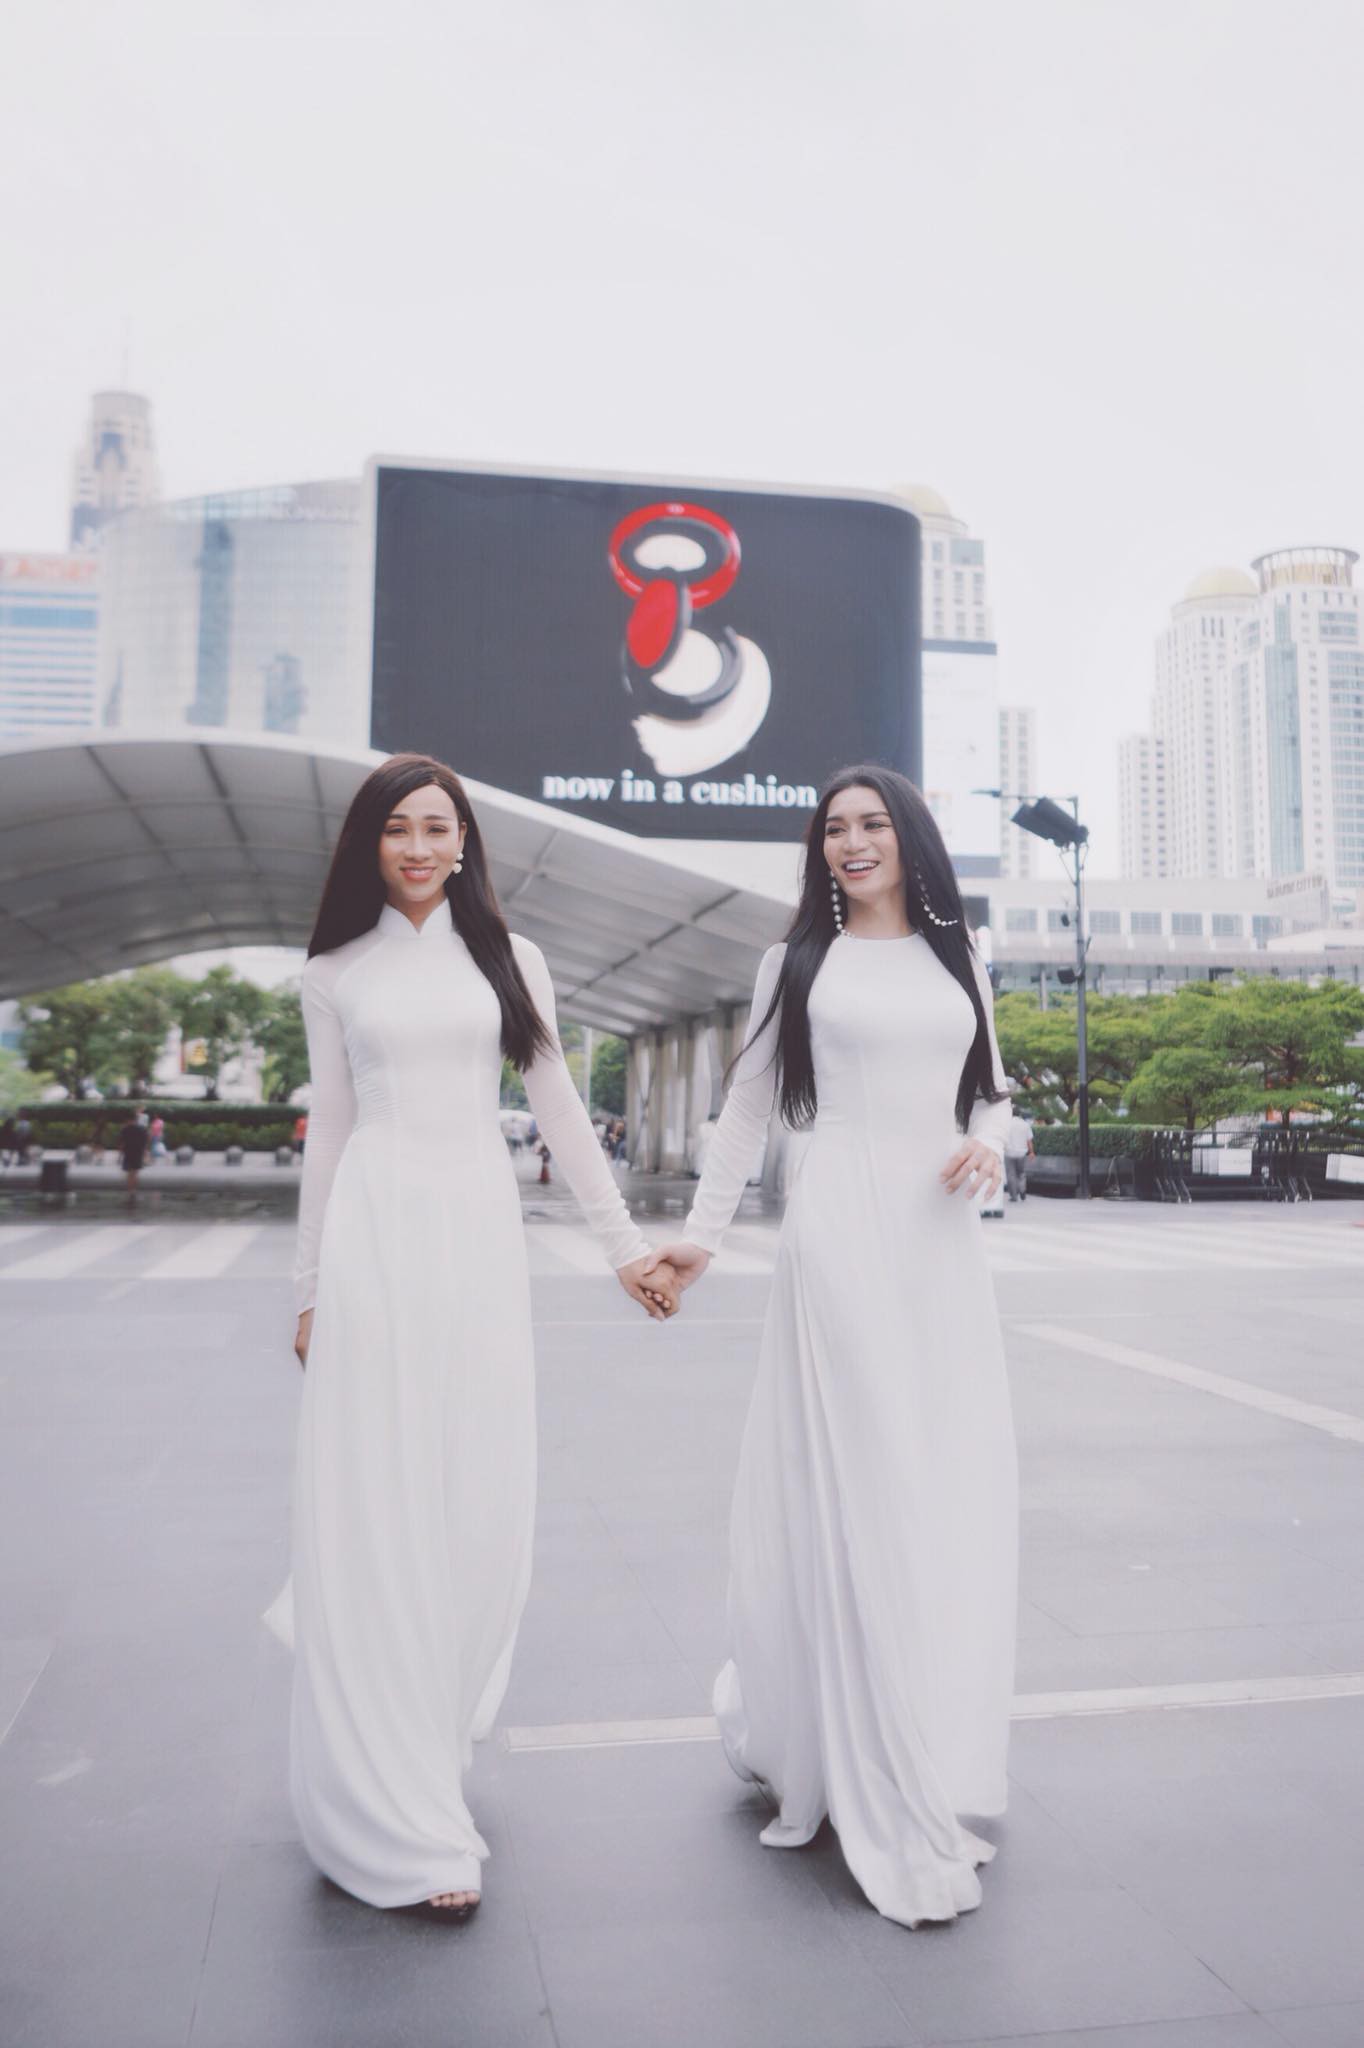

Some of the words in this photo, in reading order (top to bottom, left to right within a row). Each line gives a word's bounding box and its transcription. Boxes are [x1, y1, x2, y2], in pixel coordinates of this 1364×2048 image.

[542, 775, 615, 801] now
[621, 769, 656, 802] in
[663, 780, 685, 804] a
[690, 773, 818, 808] cushion
